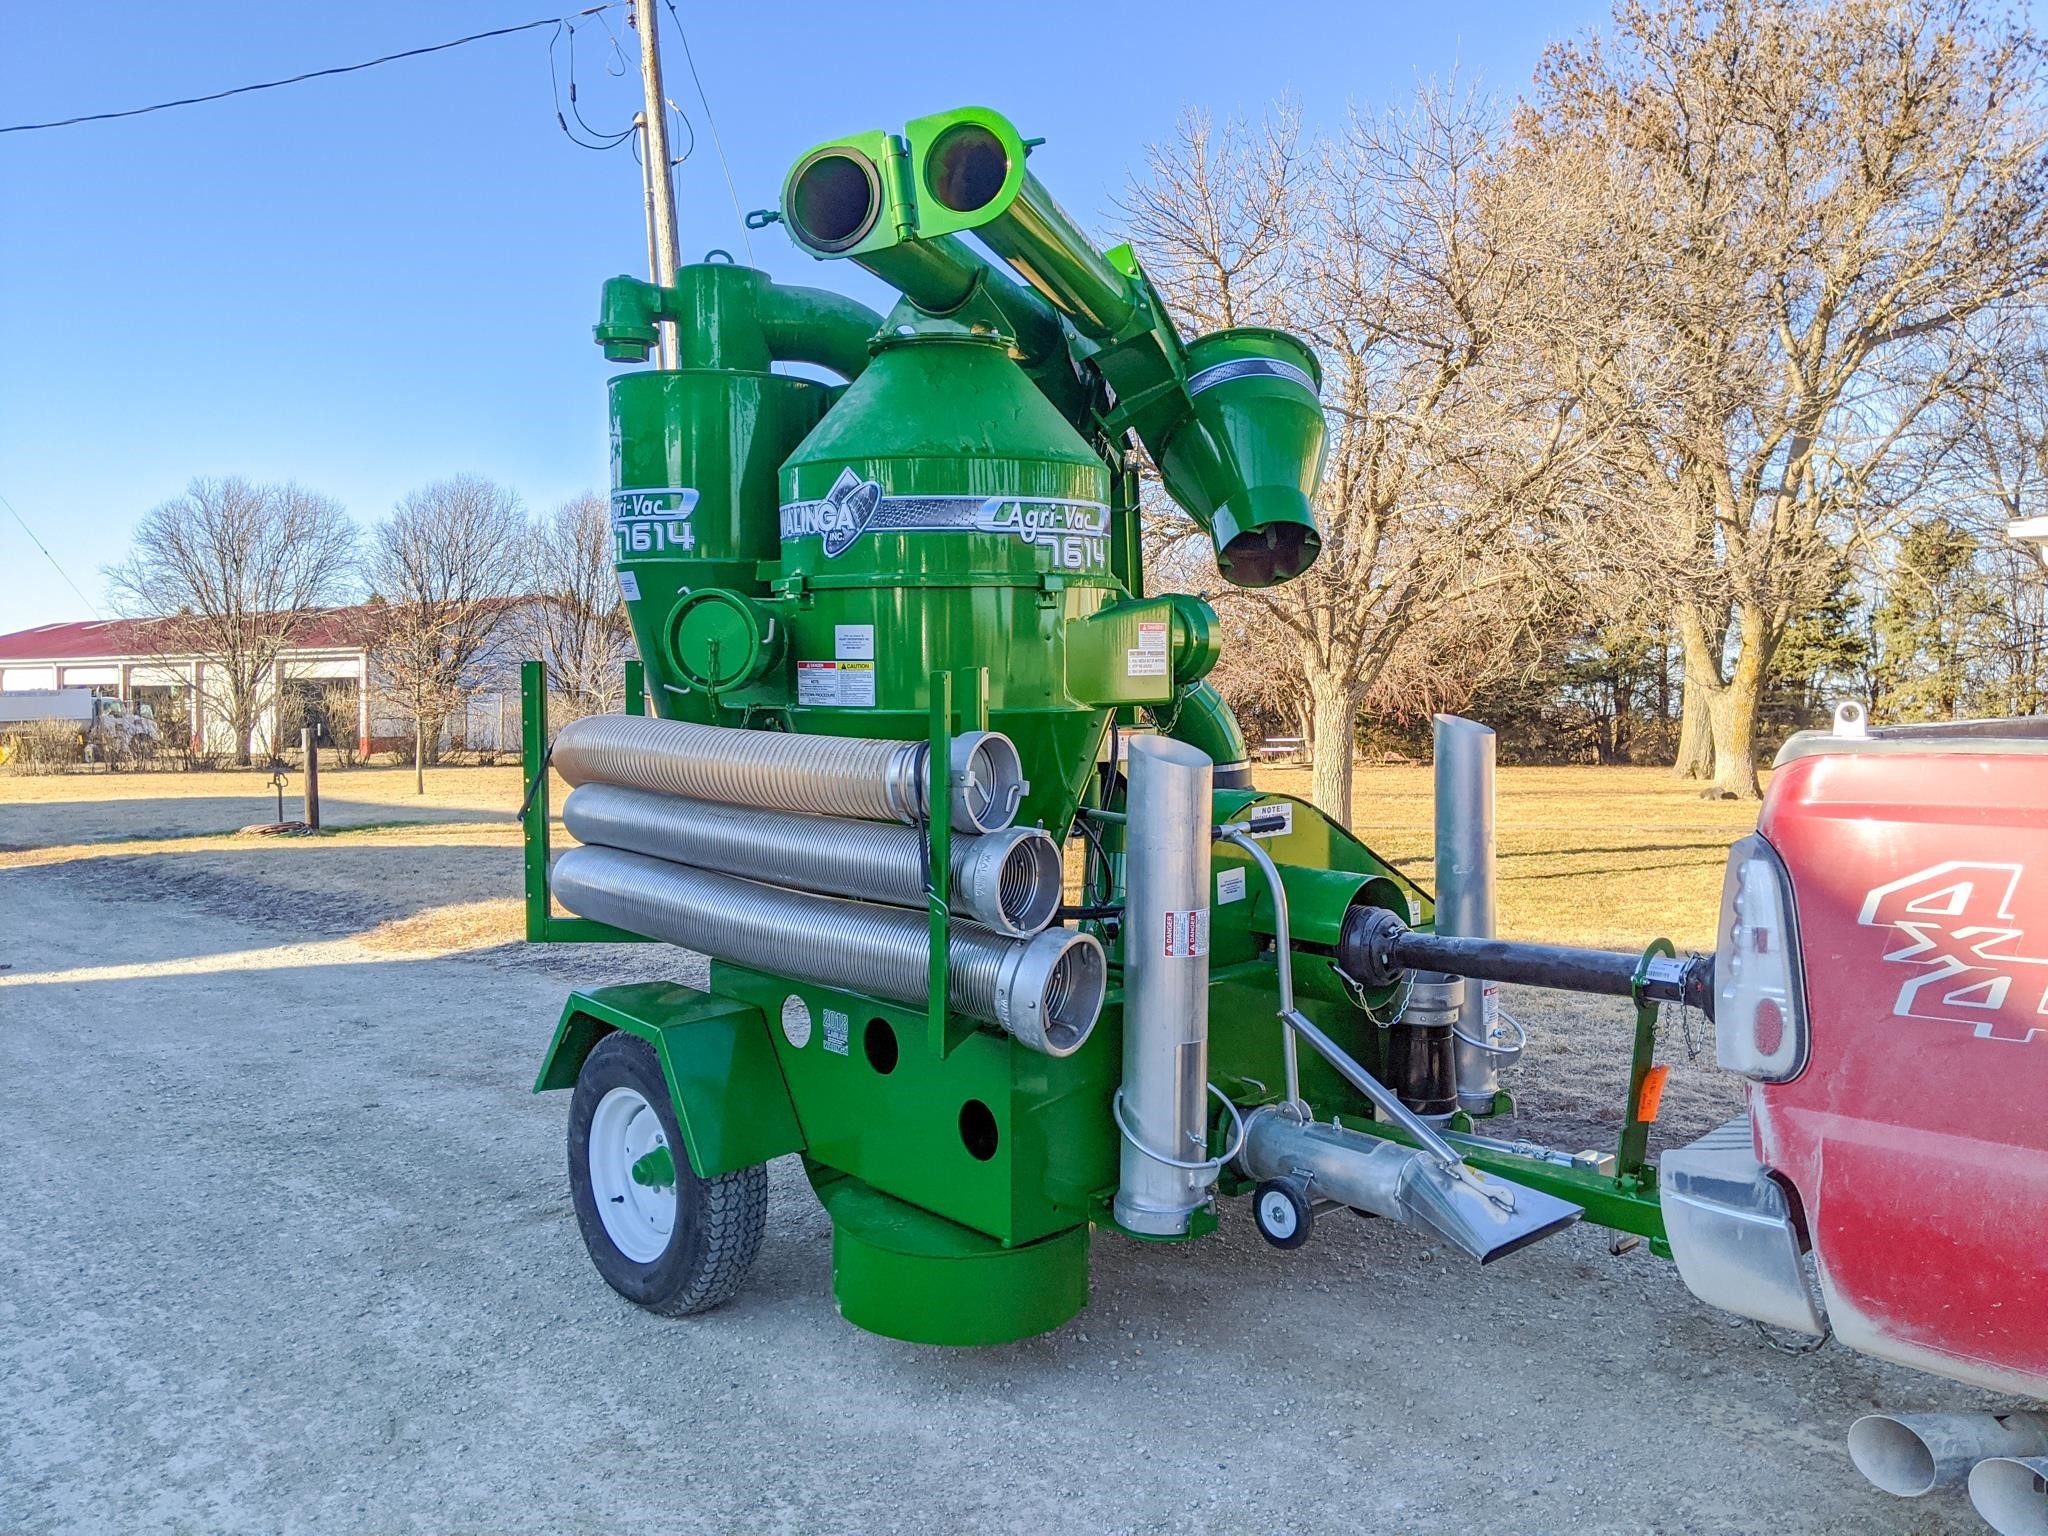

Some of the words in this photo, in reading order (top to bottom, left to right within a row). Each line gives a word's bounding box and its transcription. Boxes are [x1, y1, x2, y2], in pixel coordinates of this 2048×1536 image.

[617, 522, 696, 551] 7614
[829, 532, 845, 541] INC.
[1007, 501, 1092, 543] Agri-Vac
[1034, 535, 1105, 569] 7614
[1261, 805, 1283, 814] NOTE!
